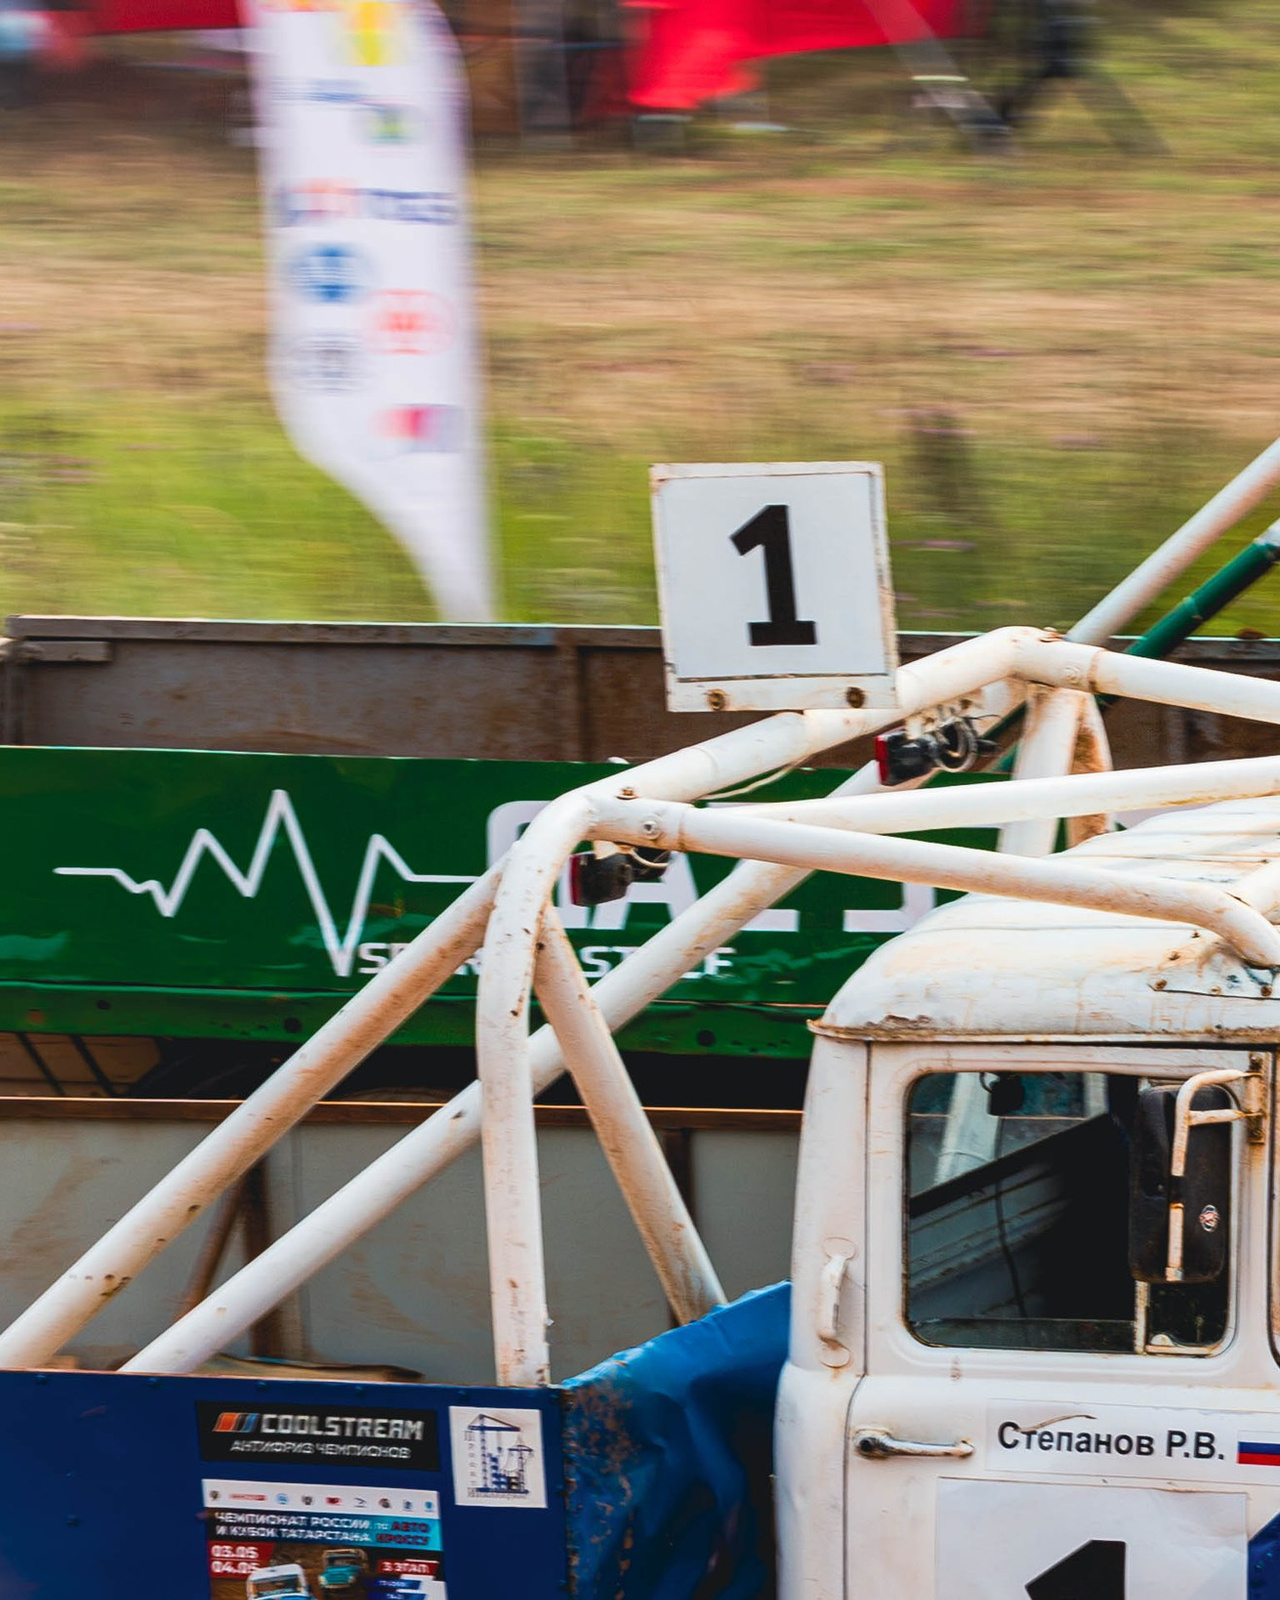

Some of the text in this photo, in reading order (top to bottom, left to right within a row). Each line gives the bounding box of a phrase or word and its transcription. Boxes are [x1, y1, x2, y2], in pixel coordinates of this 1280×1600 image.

[729, 503, 818, 648] 1
[260, 1412, 425, 1441] COOLSTREAM
[229, 1439, 412, 1459] АНТИФРИЗ ЧЕМПИОНОВ
[998, 1420, 1226, 1461] Степанов Р.В.
[214, 1511, 308, 1527] ЧЕМПИОНАТ
[310, 1515, 371, 1531] РОССИИ
[280, 1528, 372, 1543] ТАТАРСТАНА
[211, 1544, 260, 1560] 03.05
